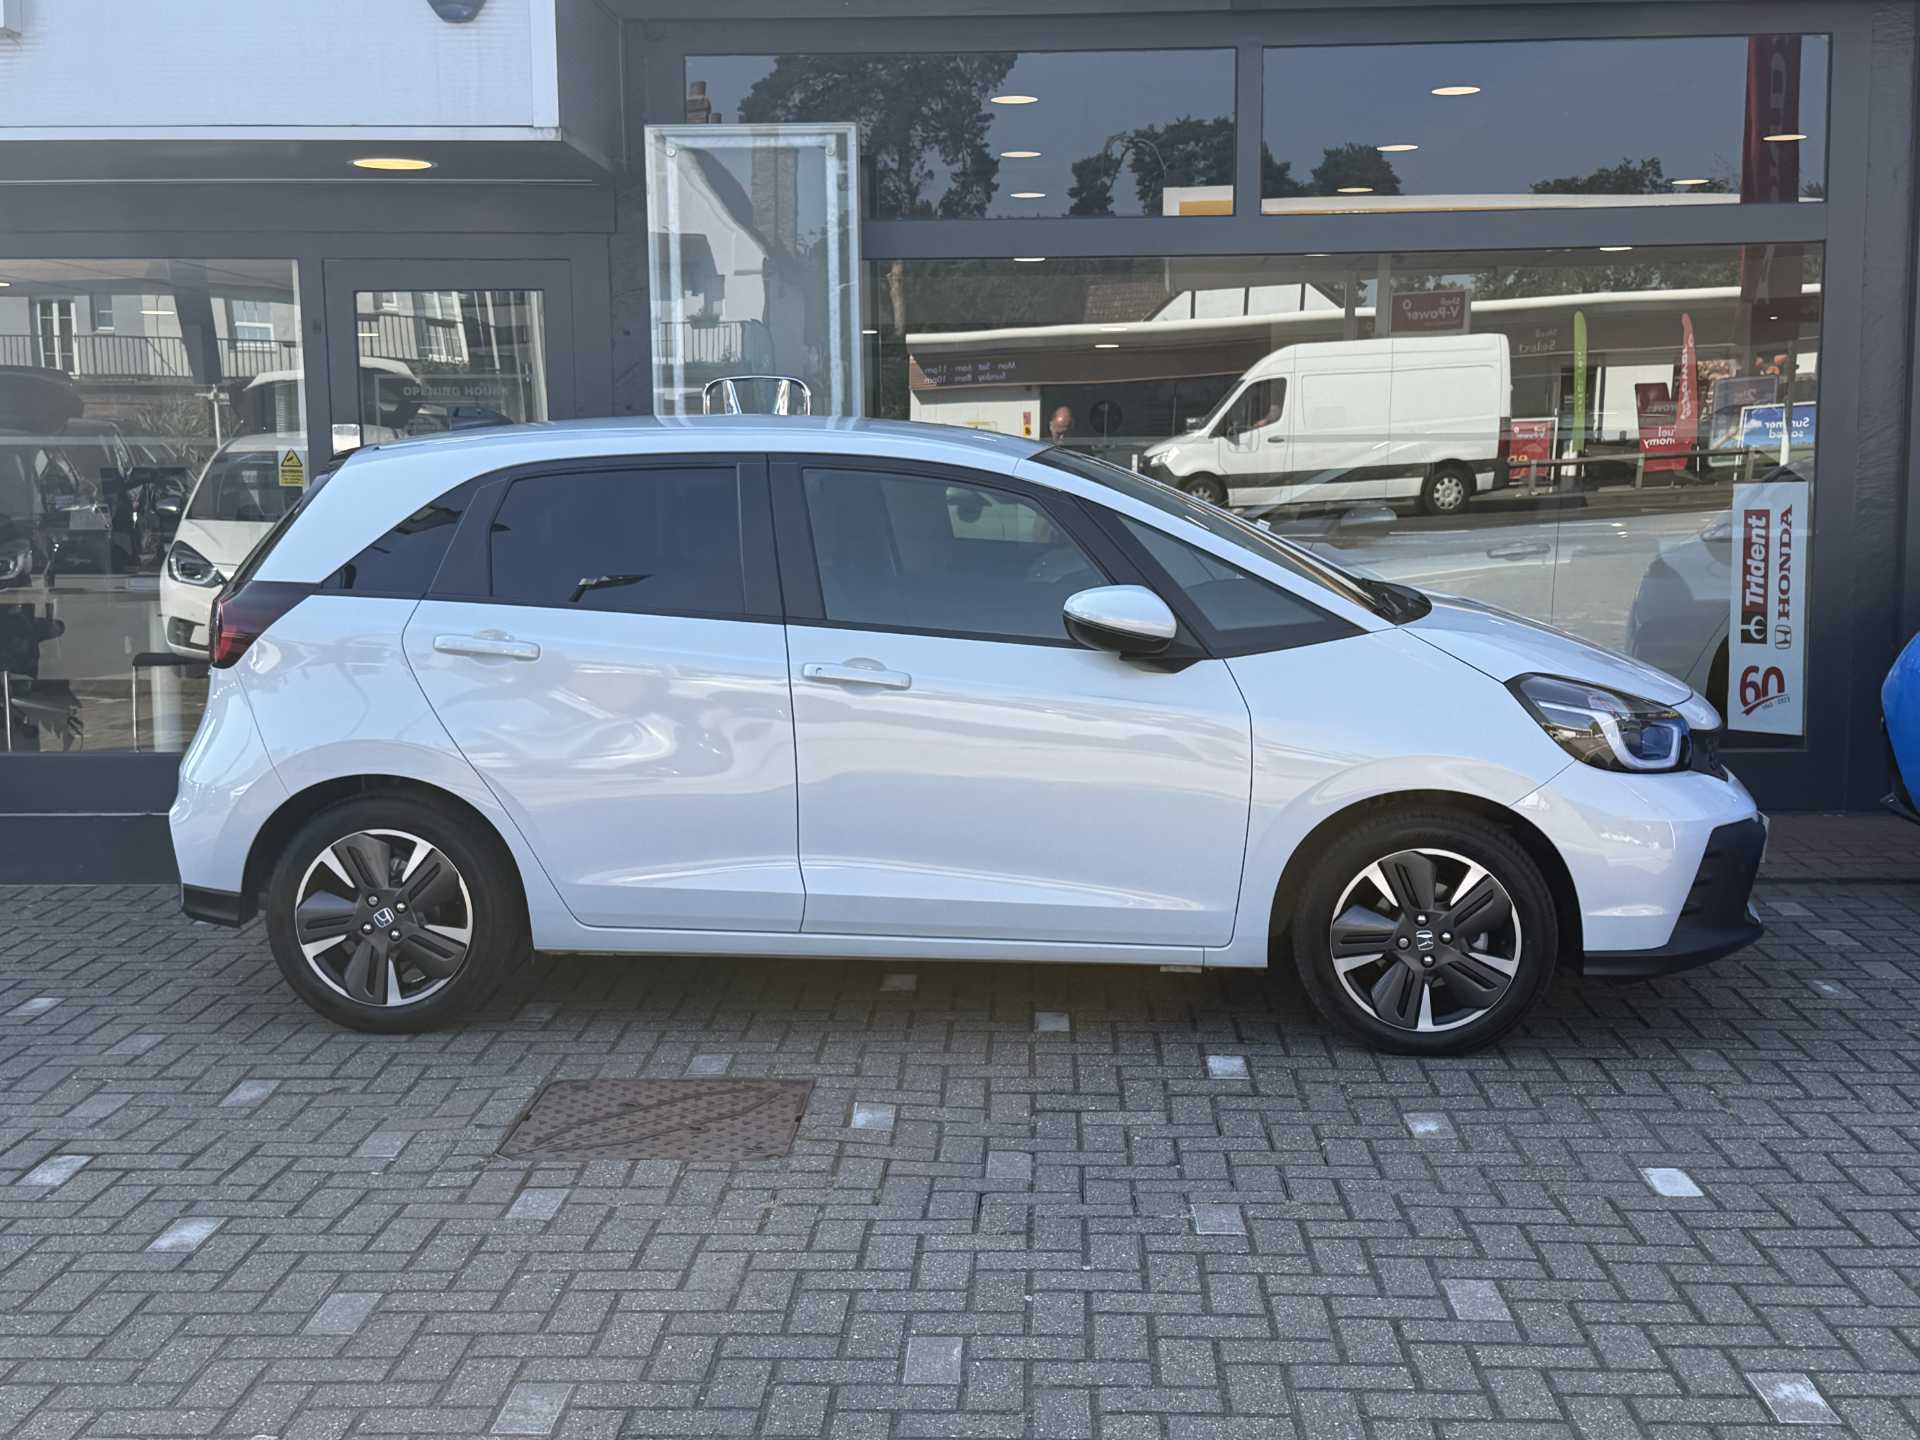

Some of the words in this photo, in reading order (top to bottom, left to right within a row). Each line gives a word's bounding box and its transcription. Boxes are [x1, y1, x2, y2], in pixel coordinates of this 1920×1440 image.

[403, 386, 461, 396] OPENING
[1745, 515, 1767, 607] Trident
[1777, 504, 1792, 620] HONDA
